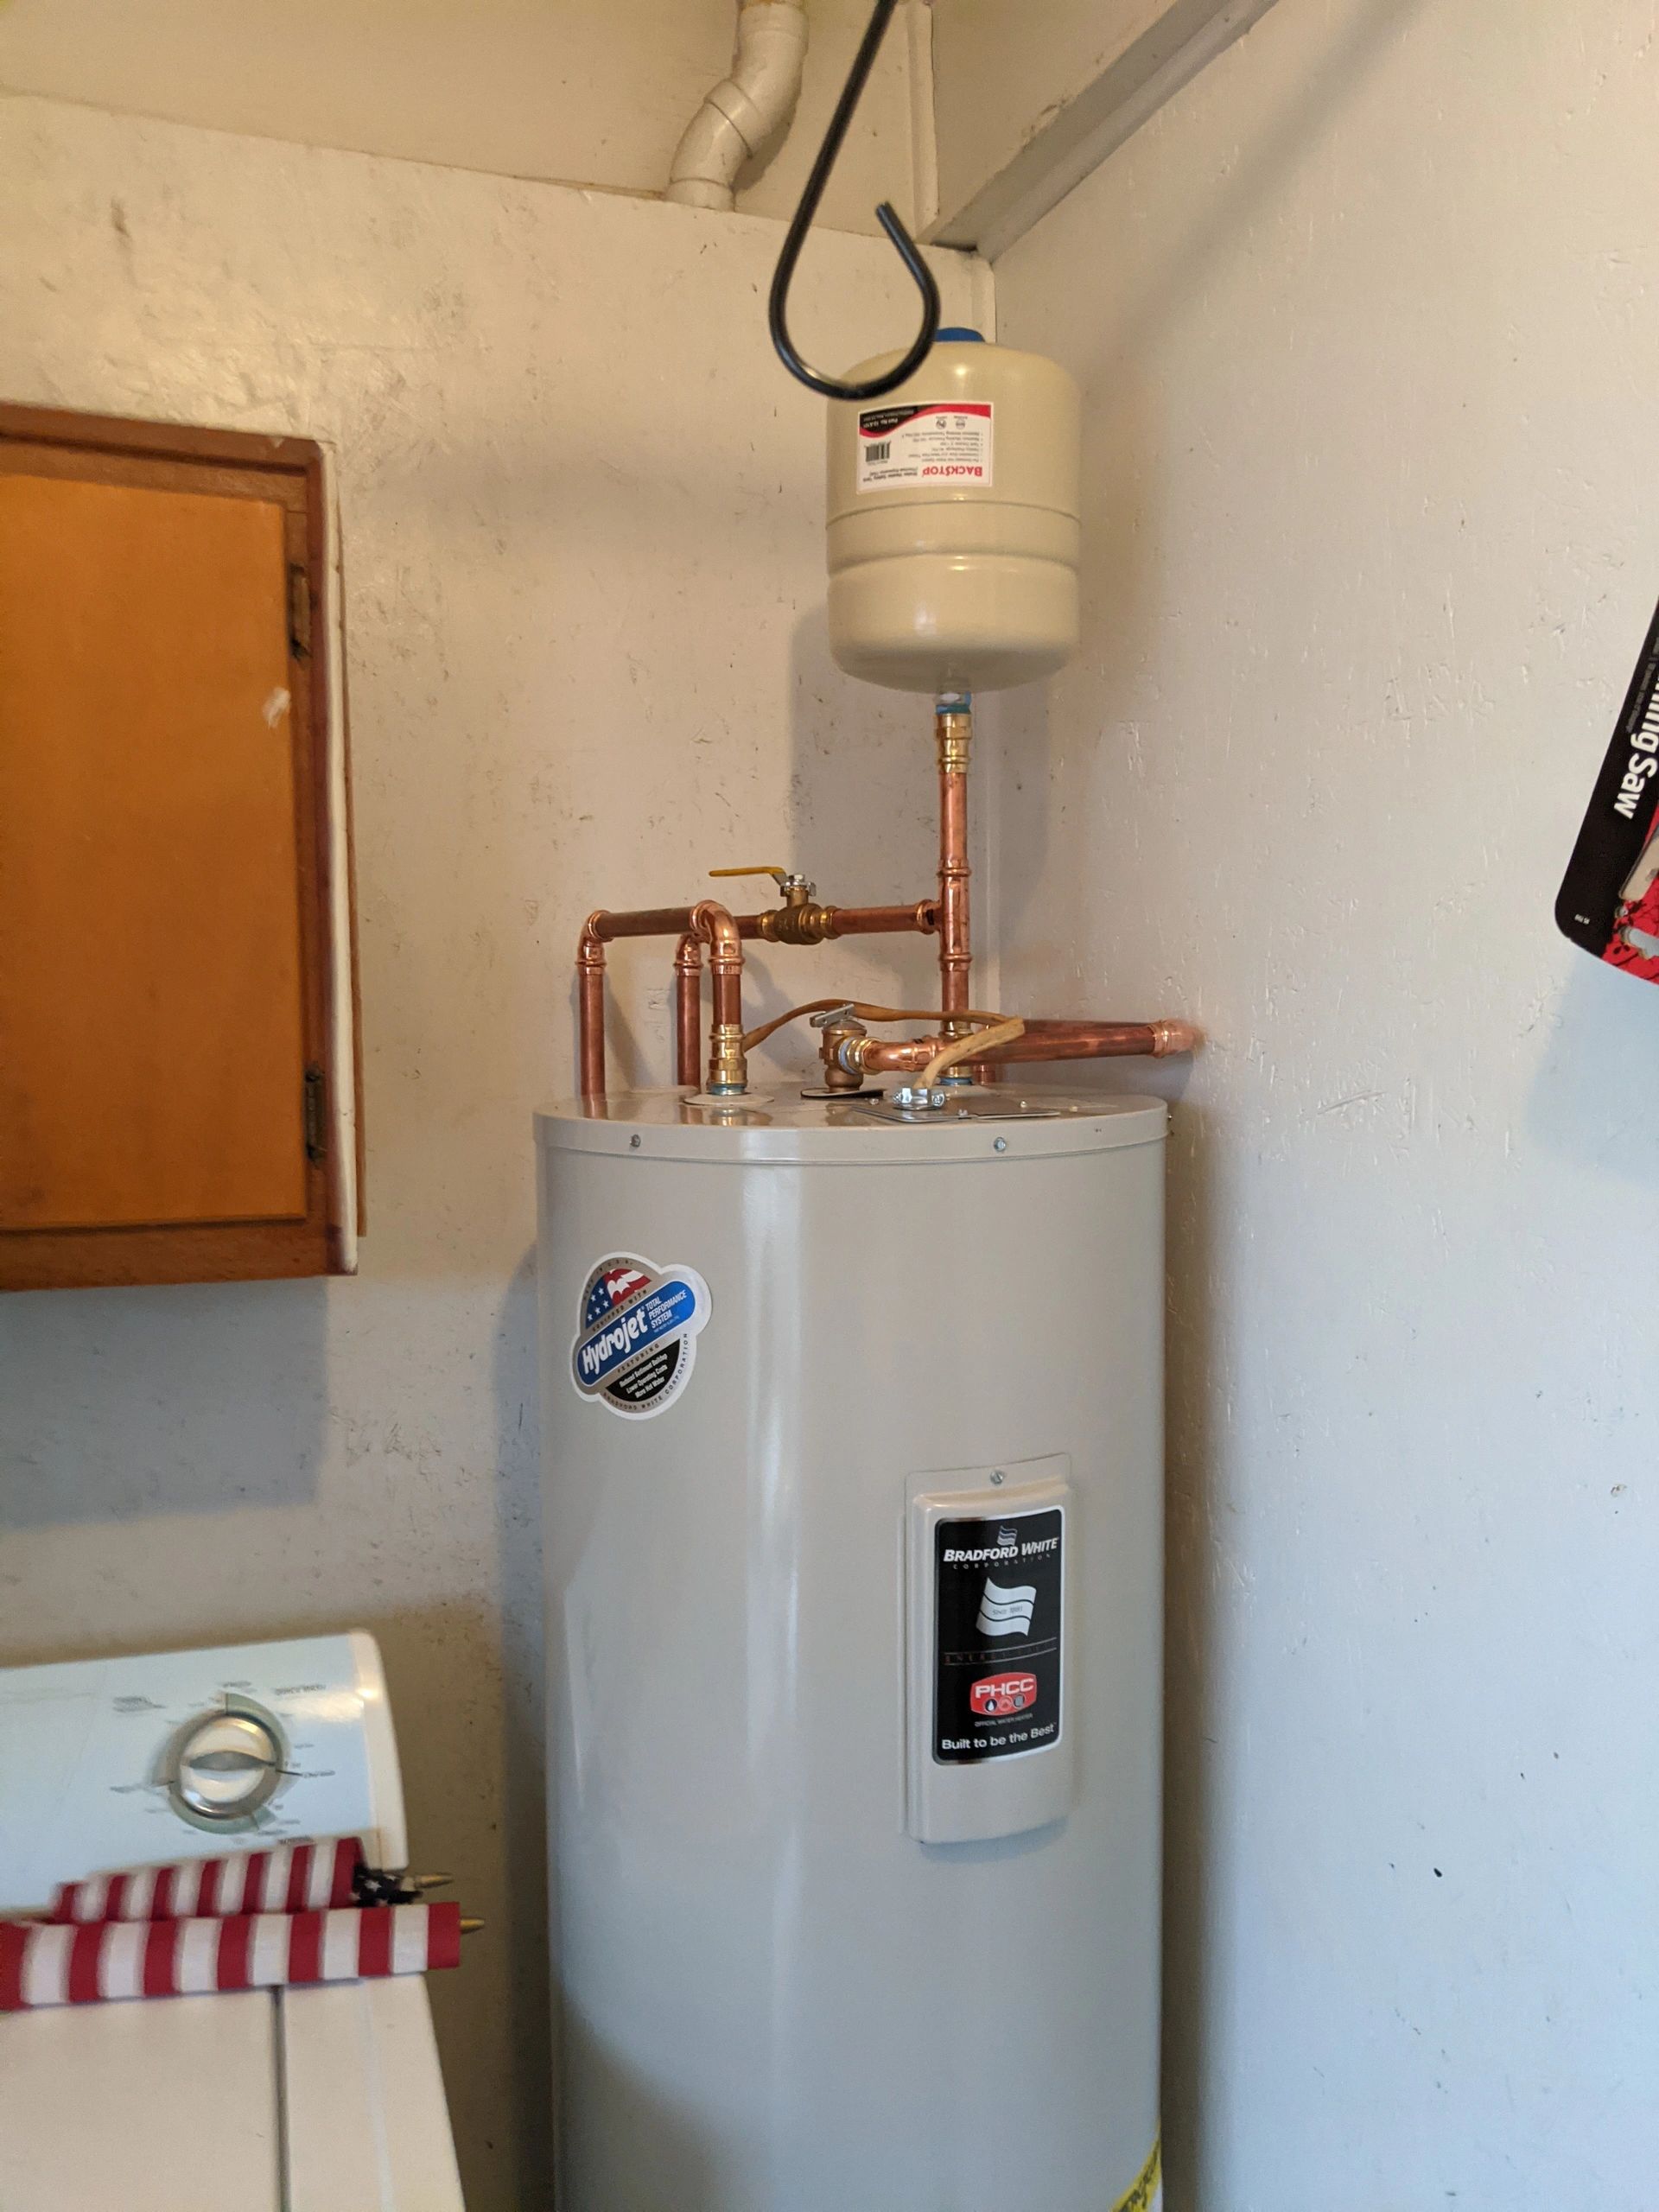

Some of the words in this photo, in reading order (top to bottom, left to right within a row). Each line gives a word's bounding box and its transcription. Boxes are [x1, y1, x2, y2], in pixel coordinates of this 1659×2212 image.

[1613, 753, 1658, 819] Saw
[645, 1296, 662, 1312] TOTAL
[648, 1289, 688, 1320] PERFORMANCE
[651, 1309, 672, 1329] SYSTEM
[582, 1308, 648, 1376] Hydrojet
[617, 1343, 659, 1373] FEATURING
[664, 1332, 689, 1395] CORPORATION
[943, 1546, 1019, 1562] BRADFORD
[1021, 1537, 1059, 1556] WHITE
[953, 1554, 1051, 1570] CORPORATION
[975, 1678, 1034, 1699] PHCC
[942, 1738, 971, 1750] Built
[973, 1738, 988, 1748] to
[990, 1736, 1007, 1746] be
[1009, 1732, 1028, 1744] the
[1031, 1724, 1054, 1738] Best
